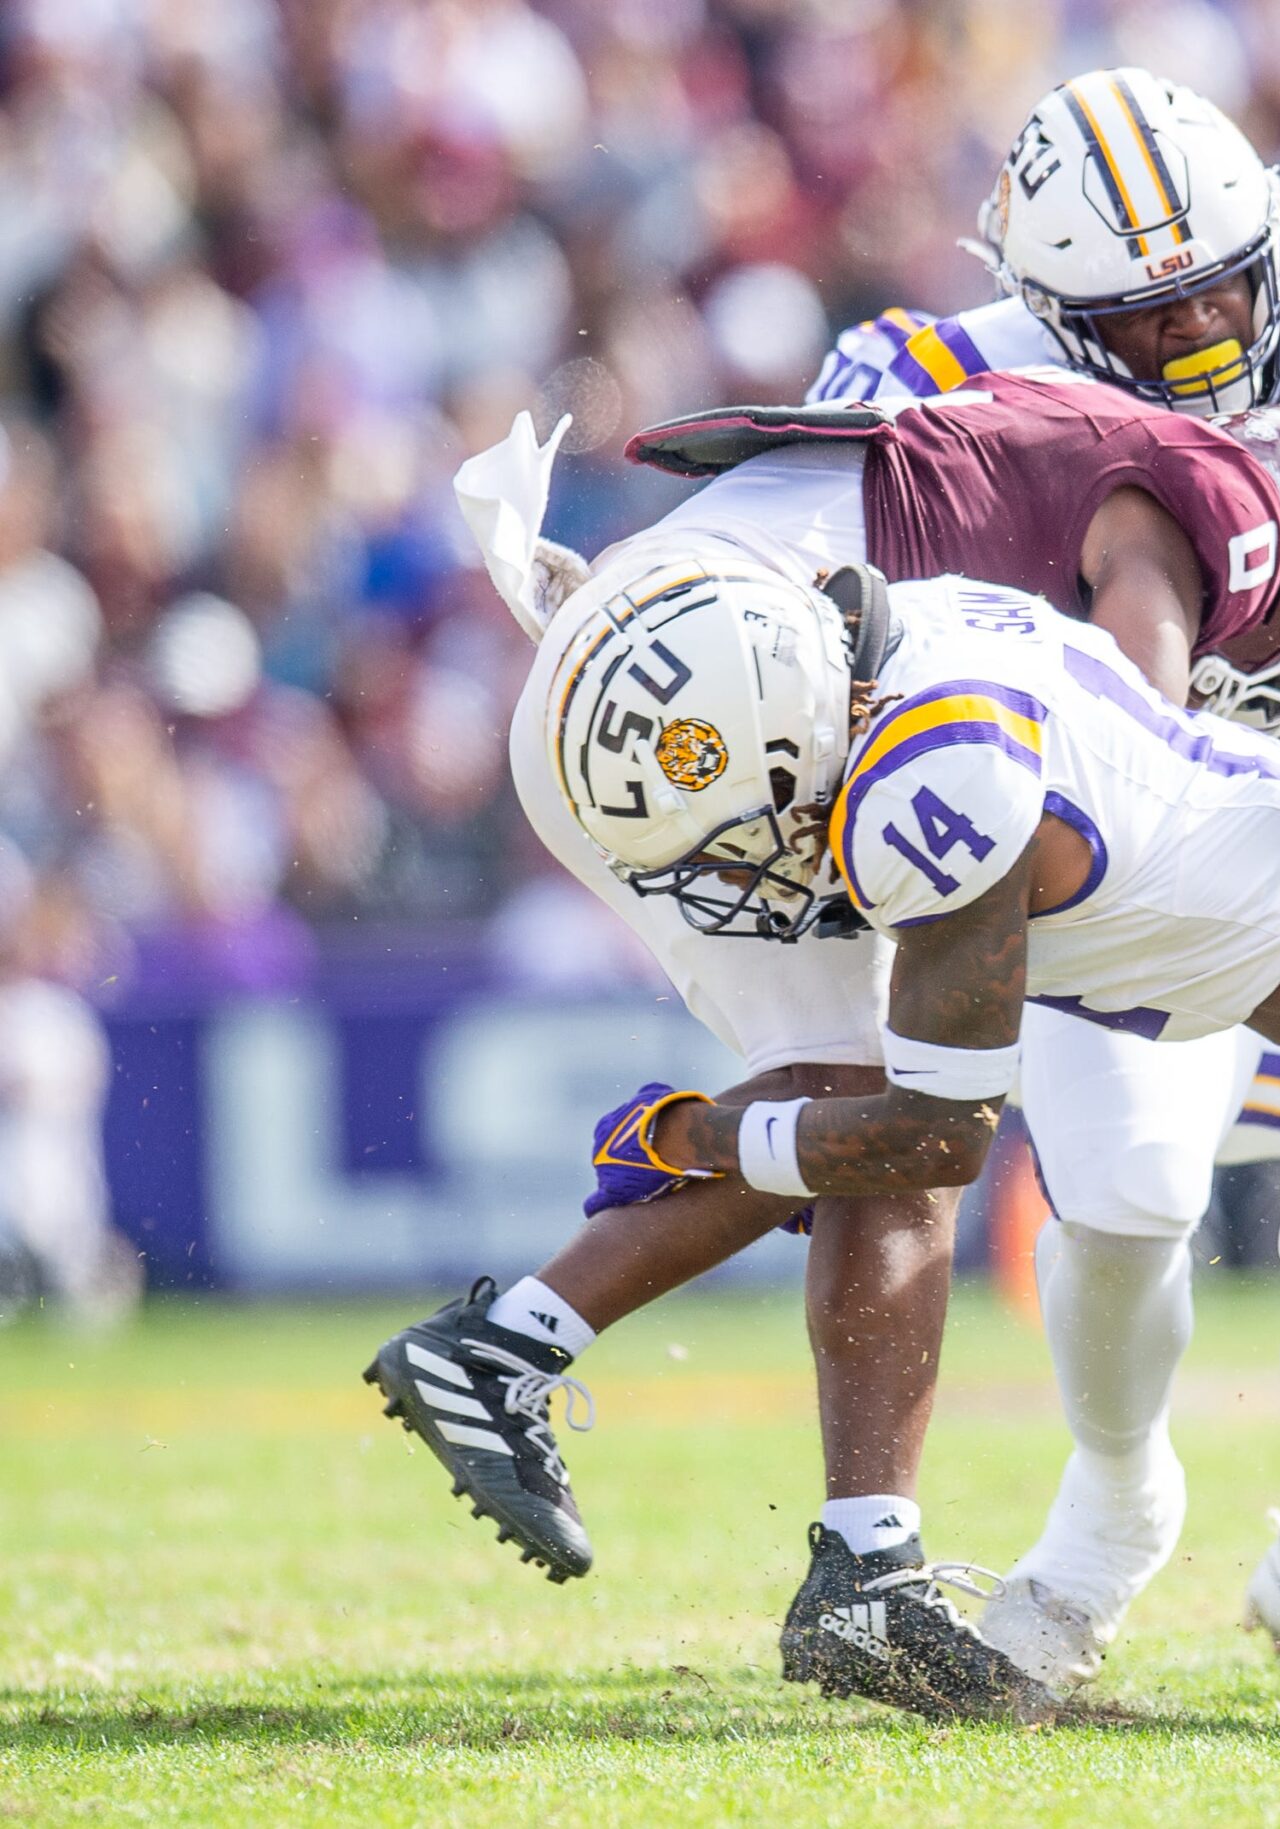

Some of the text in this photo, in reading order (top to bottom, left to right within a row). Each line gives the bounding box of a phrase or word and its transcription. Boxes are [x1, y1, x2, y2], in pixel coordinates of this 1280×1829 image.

[1145, 250, 1194, 281] LSU
[1228, 519, 1278, 594] 0
[597, 639, 693, 819] LSU
[882, 784, 998, 898] 14
